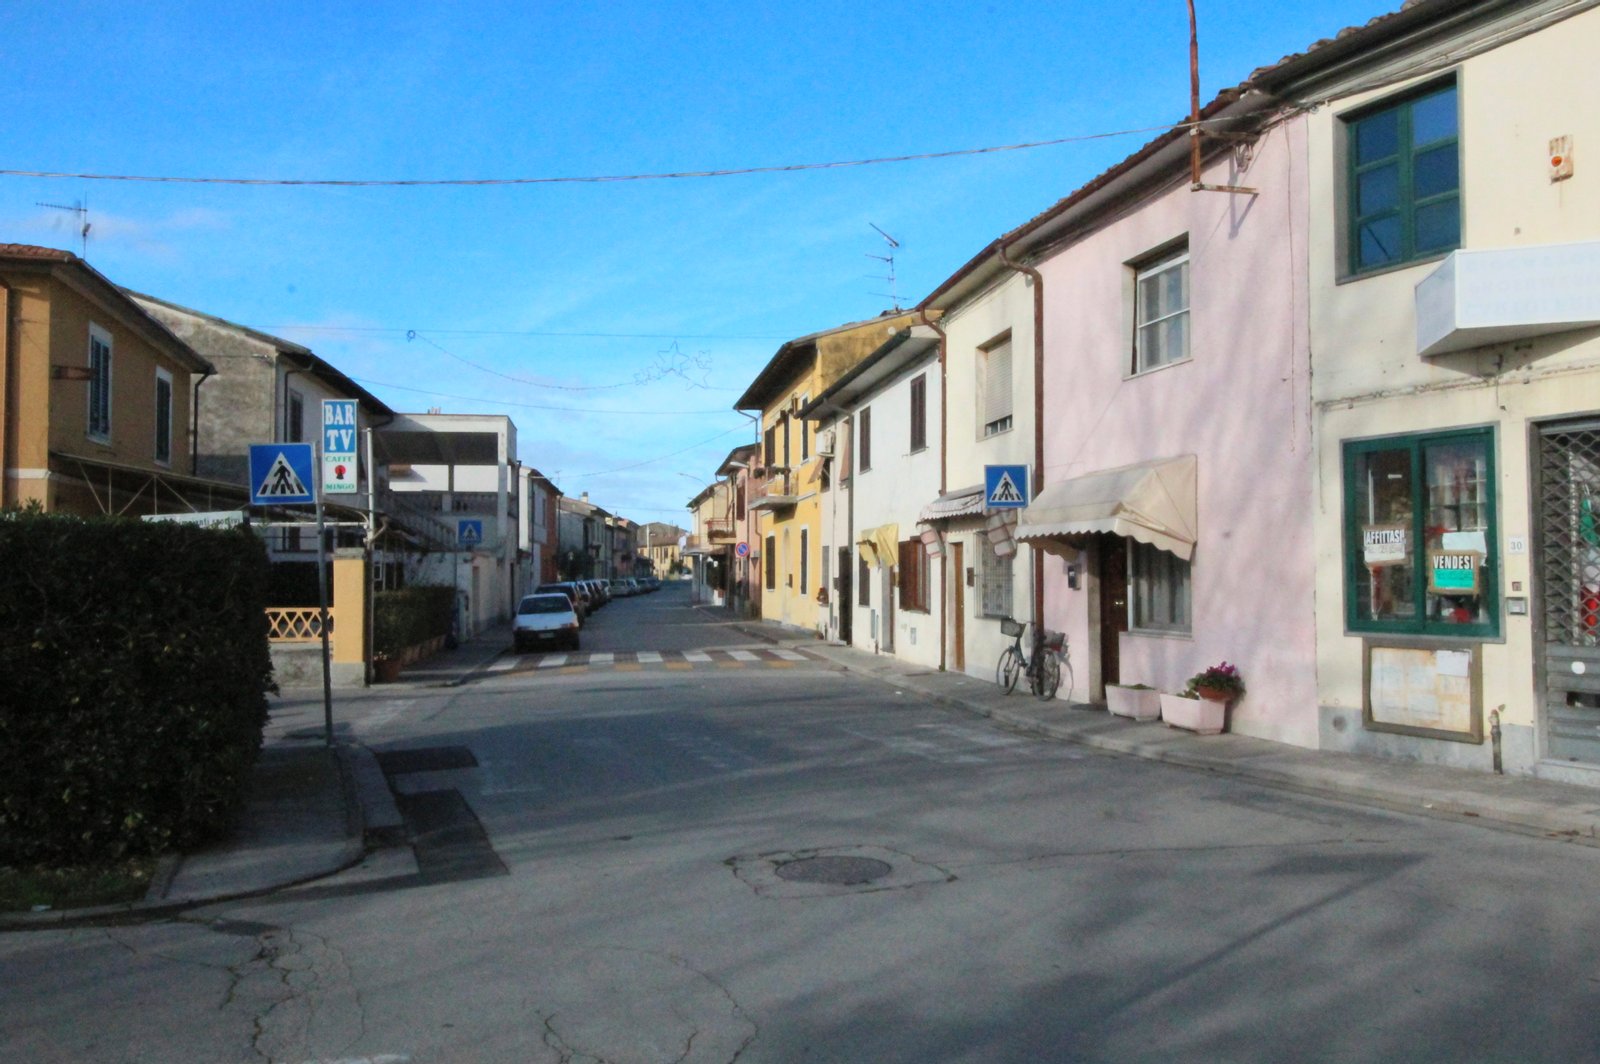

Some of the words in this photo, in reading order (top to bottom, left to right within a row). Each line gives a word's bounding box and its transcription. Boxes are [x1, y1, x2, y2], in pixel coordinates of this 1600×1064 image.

[324, 403, 354, 425] BAR
[326, 429, 353, 451] TV
[1366, 529, 1404, 545] AFFITTASI
[1433, 555, 1474, 569] VENDESI
